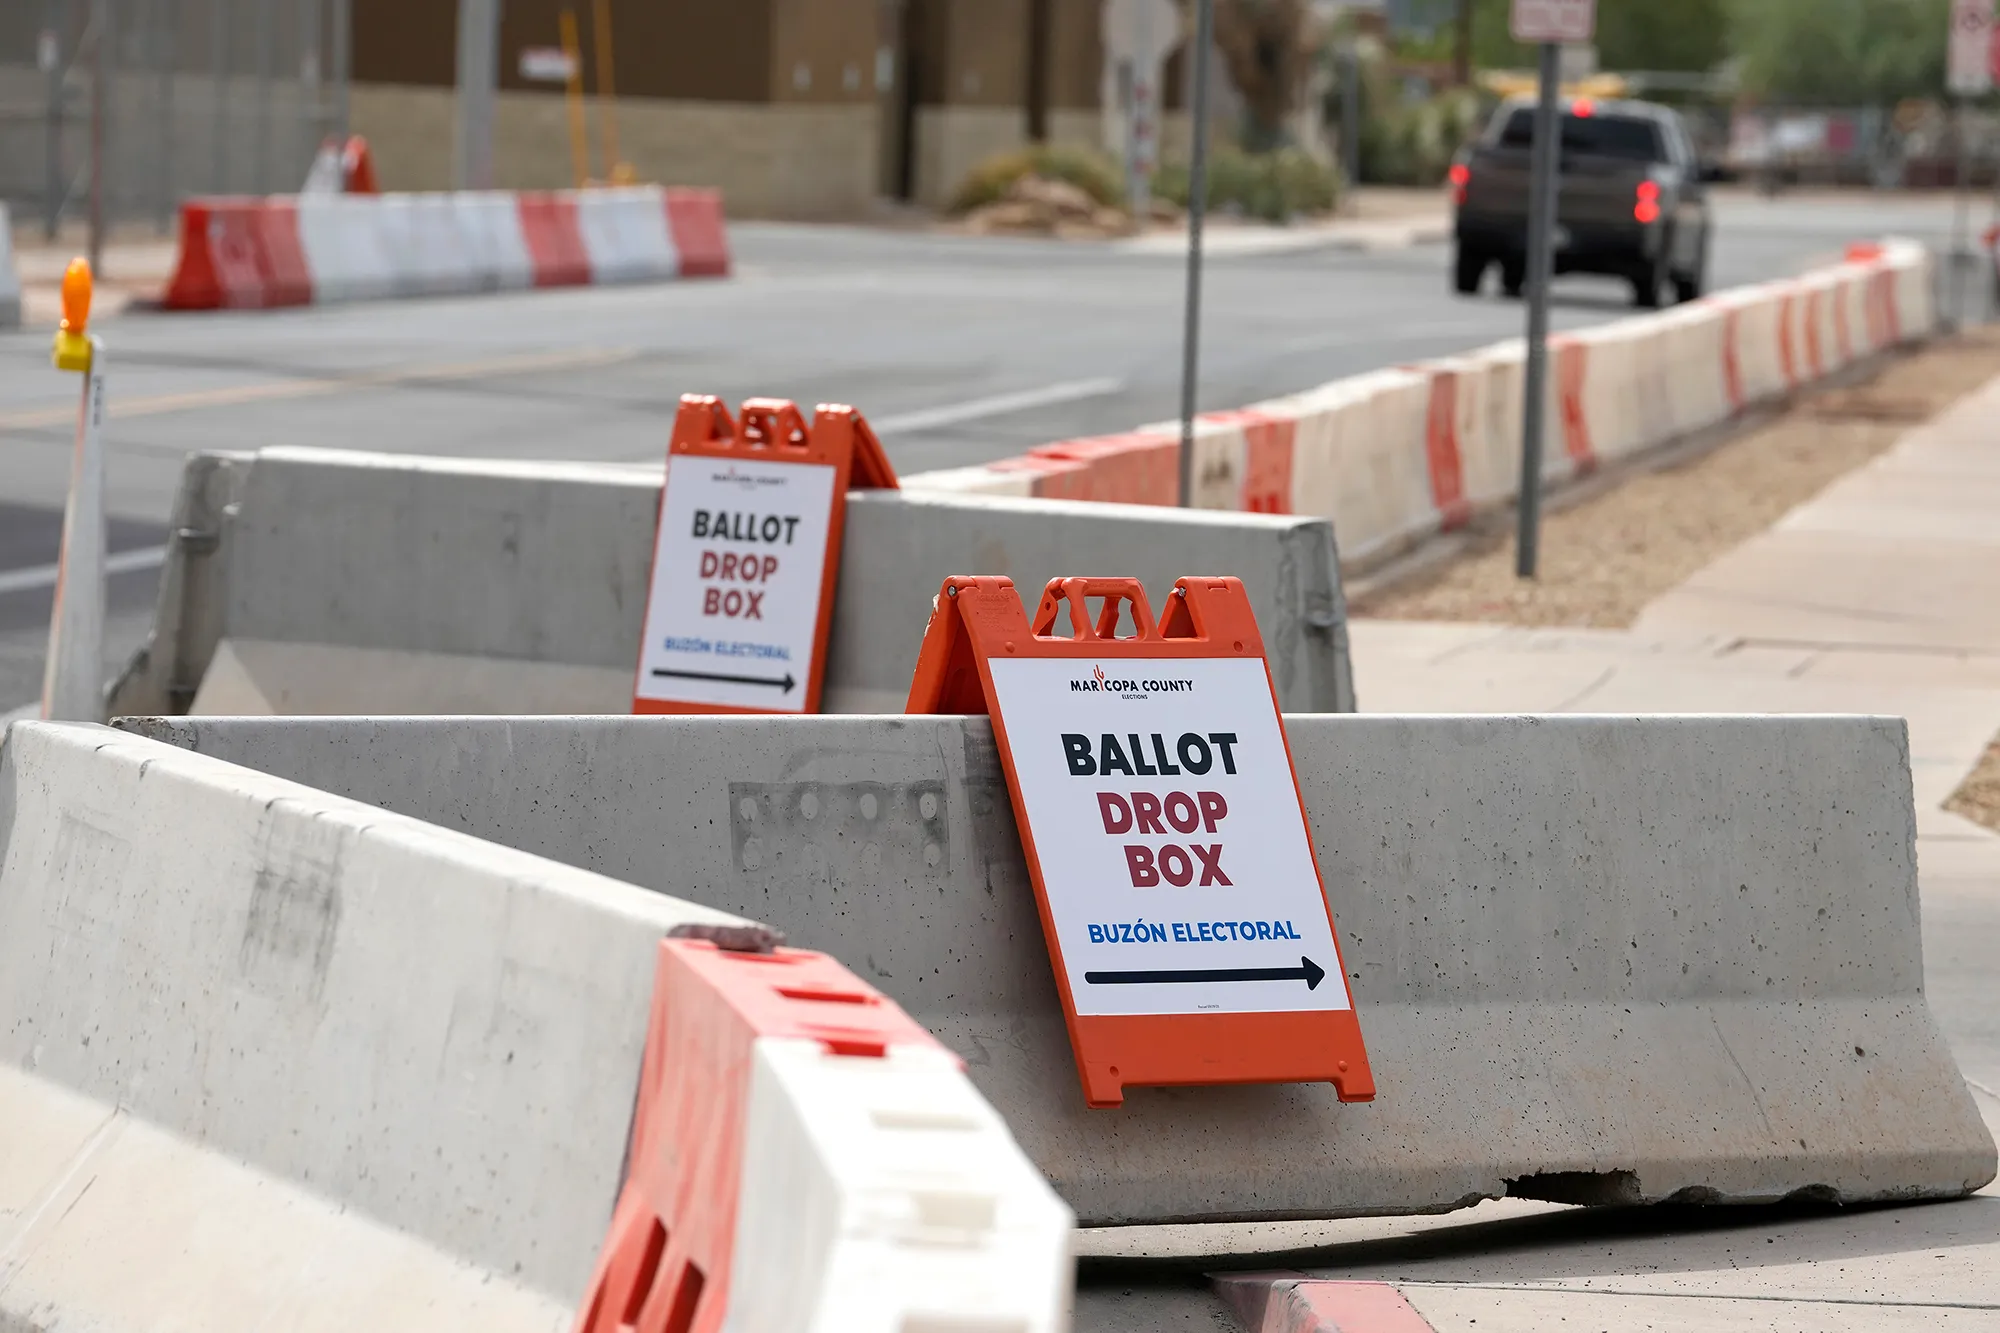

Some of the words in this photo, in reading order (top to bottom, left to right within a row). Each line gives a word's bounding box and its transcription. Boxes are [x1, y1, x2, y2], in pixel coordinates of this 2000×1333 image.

[692, 509, 800, 545] BALLOT
[700, 550, 778, 584] DROP
[703, 587, 764, 621] BOX
[715, 641, 790, 661] ELECTORAL
[1142, 680, 1193, 692] COUNTY
[1060, 732, 1239, 776] BALLOT
[1096, 791, 1228, 835] DROP
[1123, 844, 1233, 888] BOX
[1088, 918, 1168, 944] BUZÓN
[1172, 920, 1301, 943] ELECTORAL
